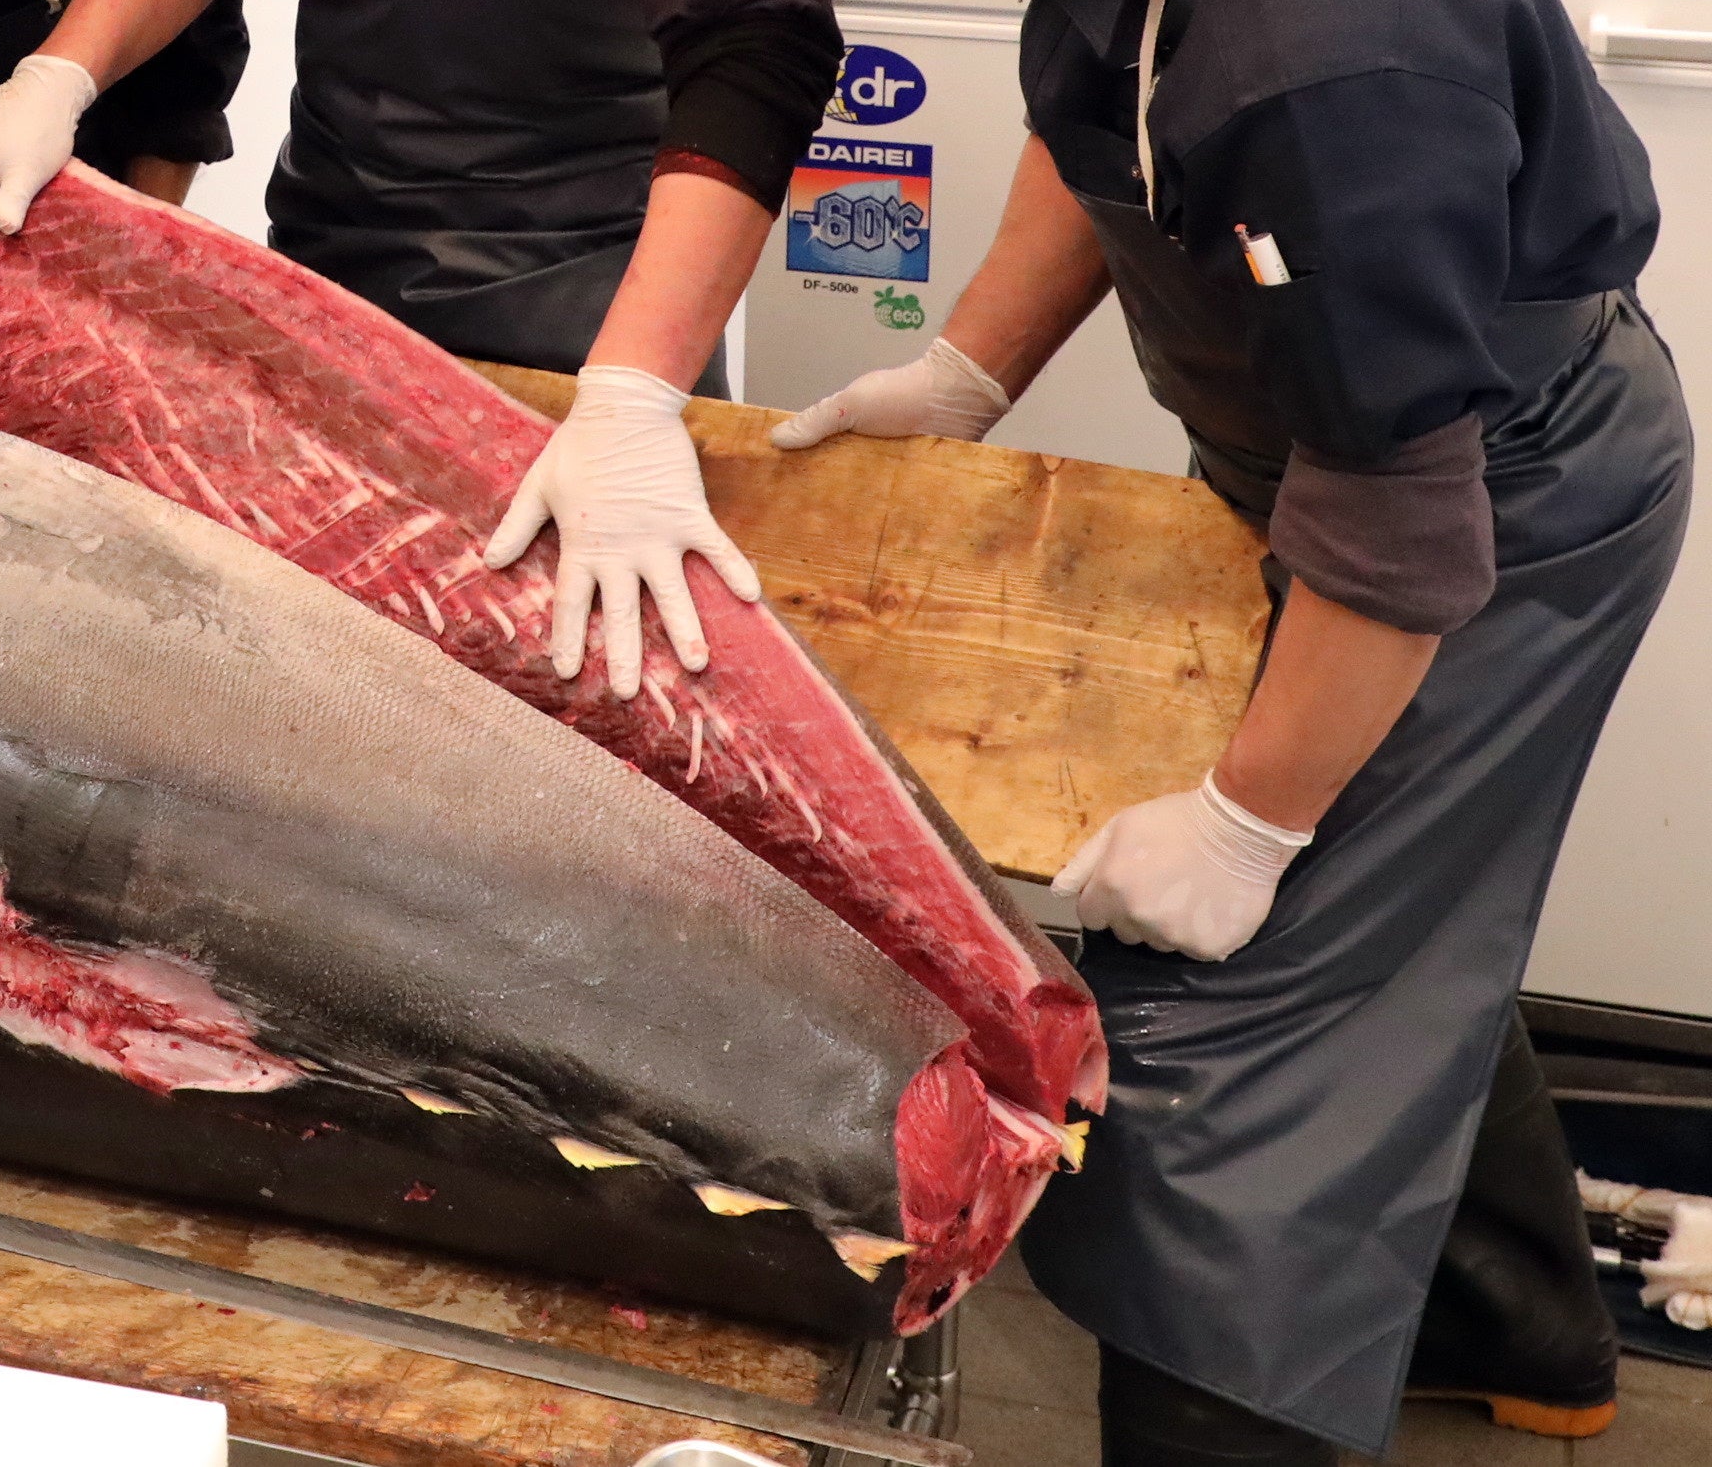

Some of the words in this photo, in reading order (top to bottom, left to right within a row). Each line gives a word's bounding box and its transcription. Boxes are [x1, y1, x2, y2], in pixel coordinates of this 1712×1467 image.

[808, 142, 913, 168] DAIREI
[803, 278, 859, 294] DF-500e
[893, 308, 922, 324] eco
